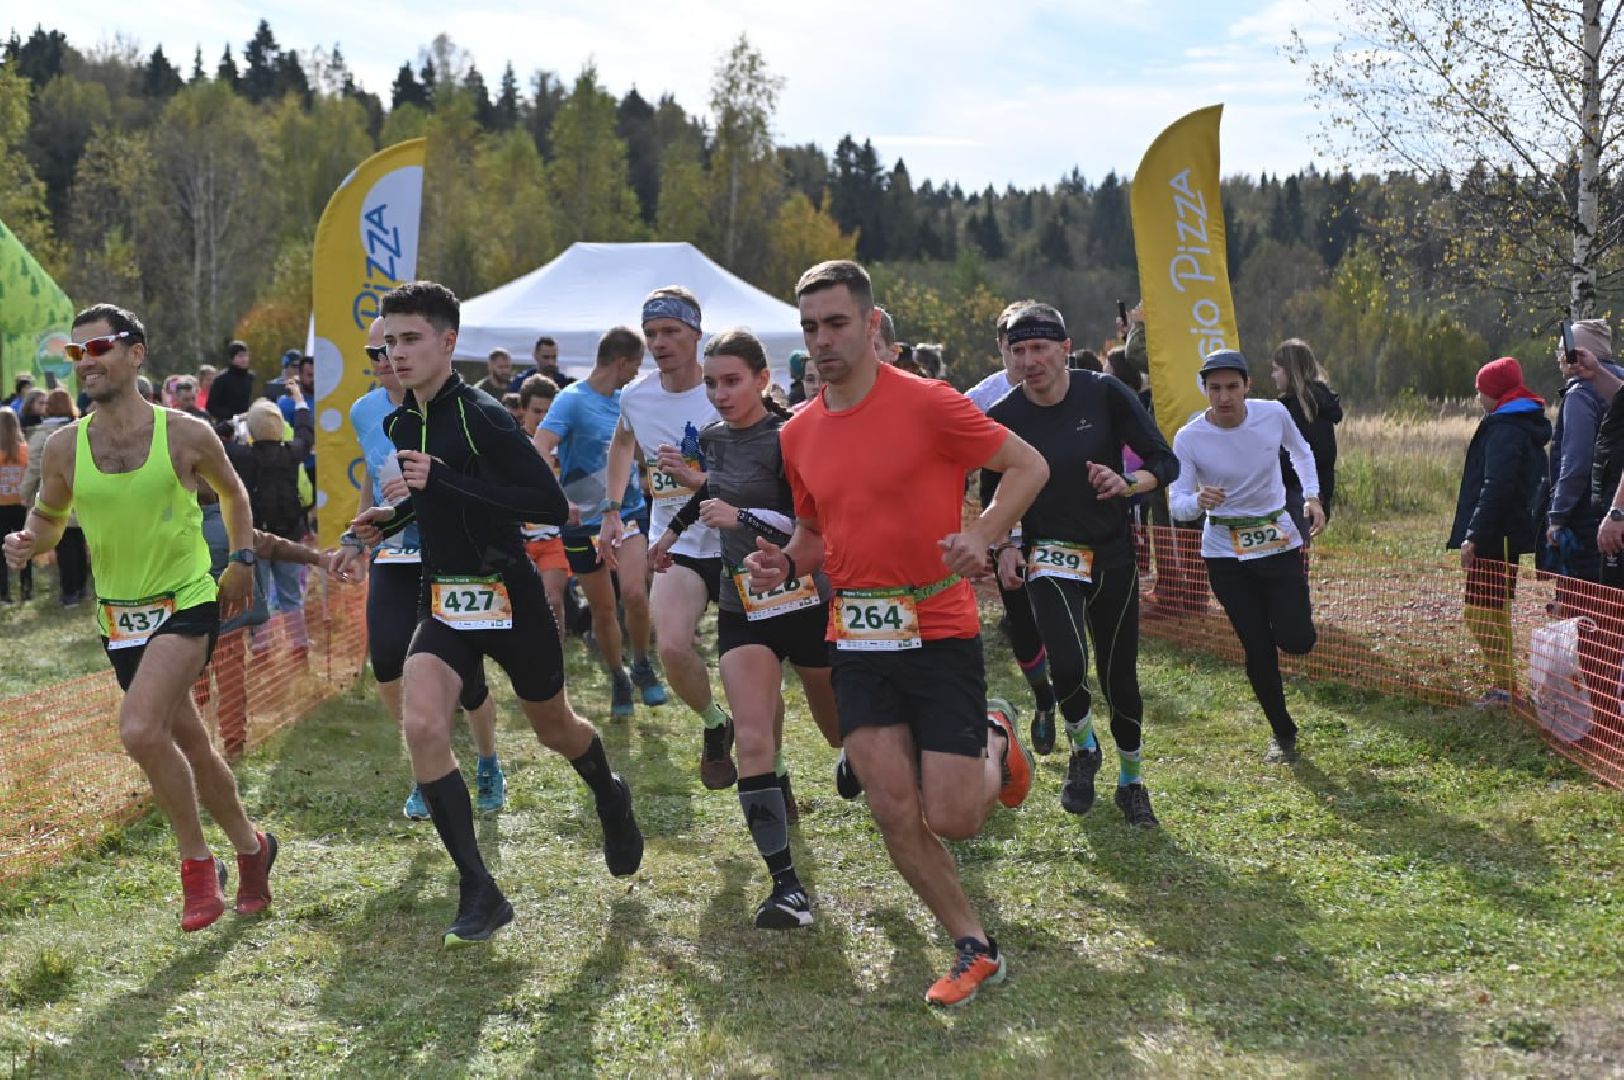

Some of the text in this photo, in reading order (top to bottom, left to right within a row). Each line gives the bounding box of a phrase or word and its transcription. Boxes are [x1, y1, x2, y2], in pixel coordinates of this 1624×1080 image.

[653, 472, 679, 491] 34
[1240, 528, 1281, 547] 392
[1036, 548, 1080, 569] 289
[445, 590, 494, 612] 427
[119, 608, 164, 632] 437
[846, 605, 903, 629] 264
